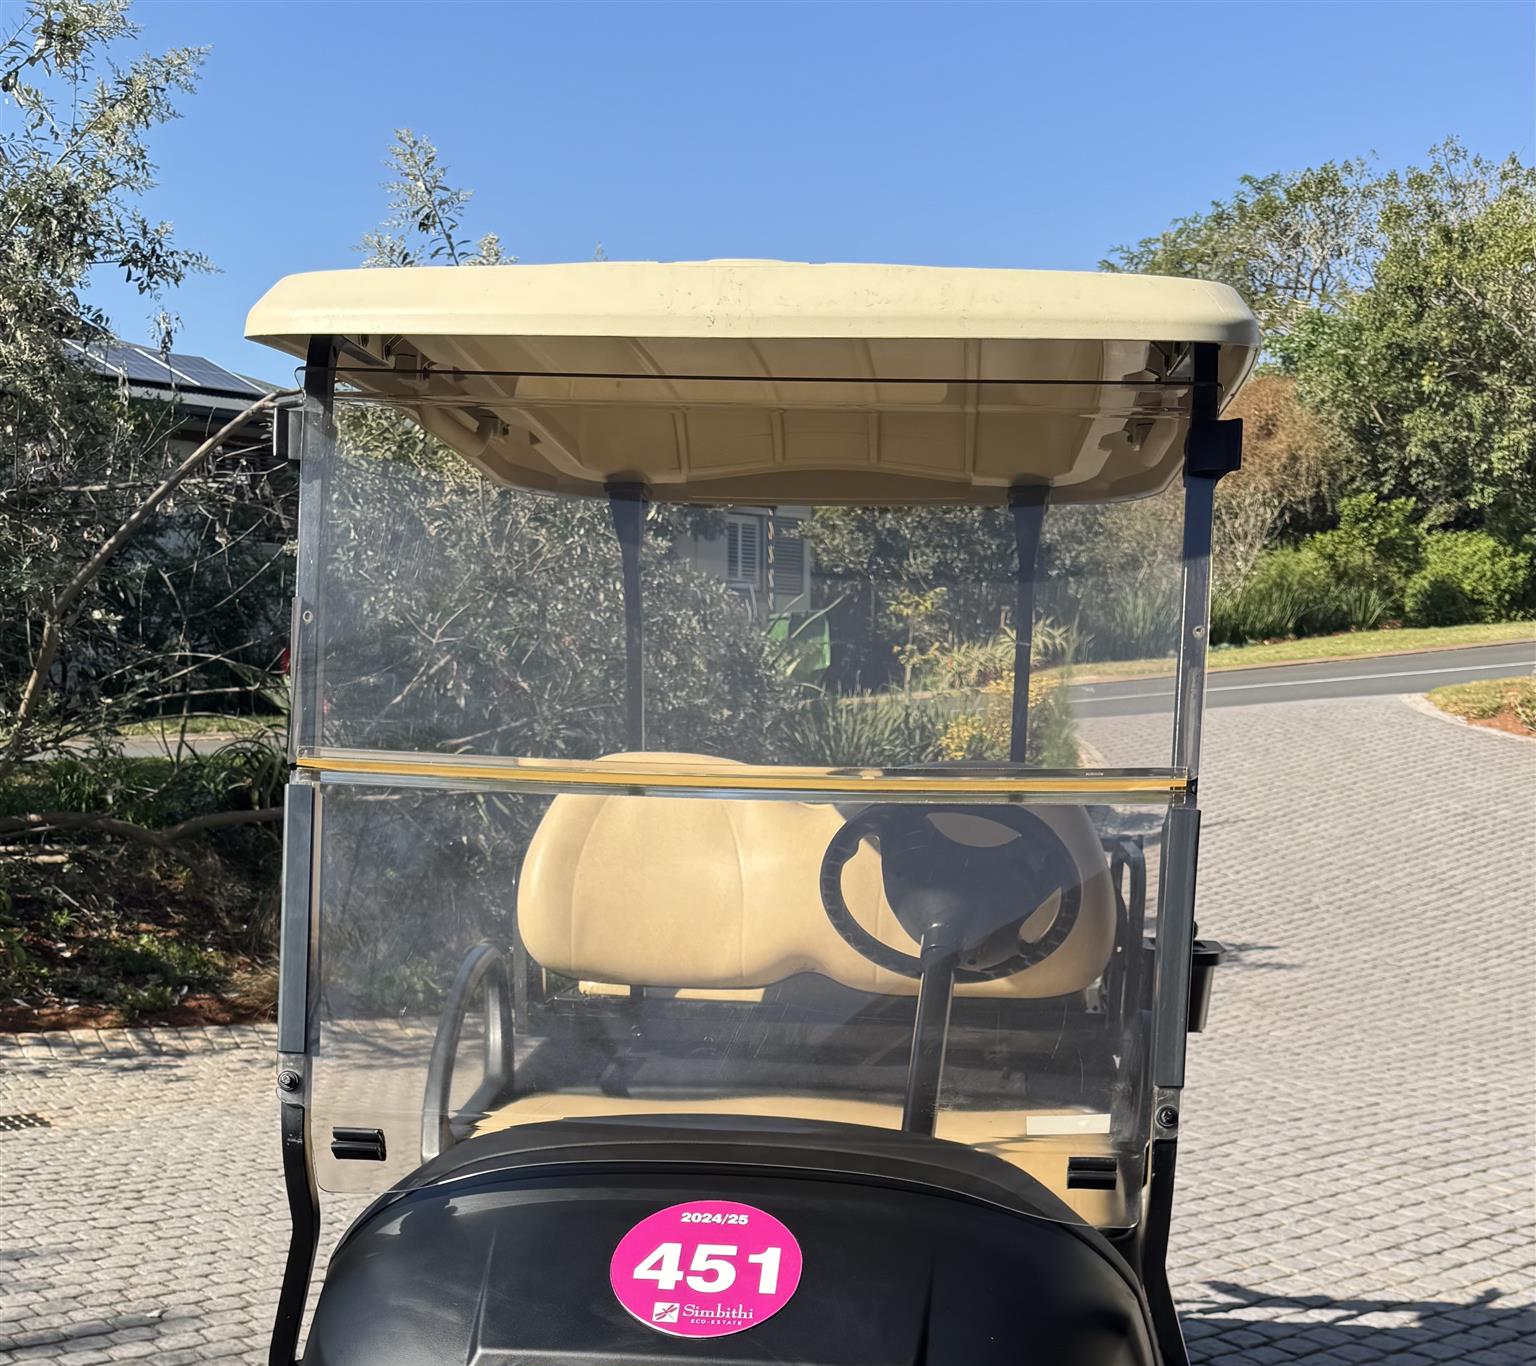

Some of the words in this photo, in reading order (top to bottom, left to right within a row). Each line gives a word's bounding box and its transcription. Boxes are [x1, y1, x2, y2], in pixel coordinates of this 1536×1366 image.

[680, 1212, 749, 1226] 2024/25
[632, 1242, 782, 1295] 451
[682, 1303, 754, 1320] Simbithi
